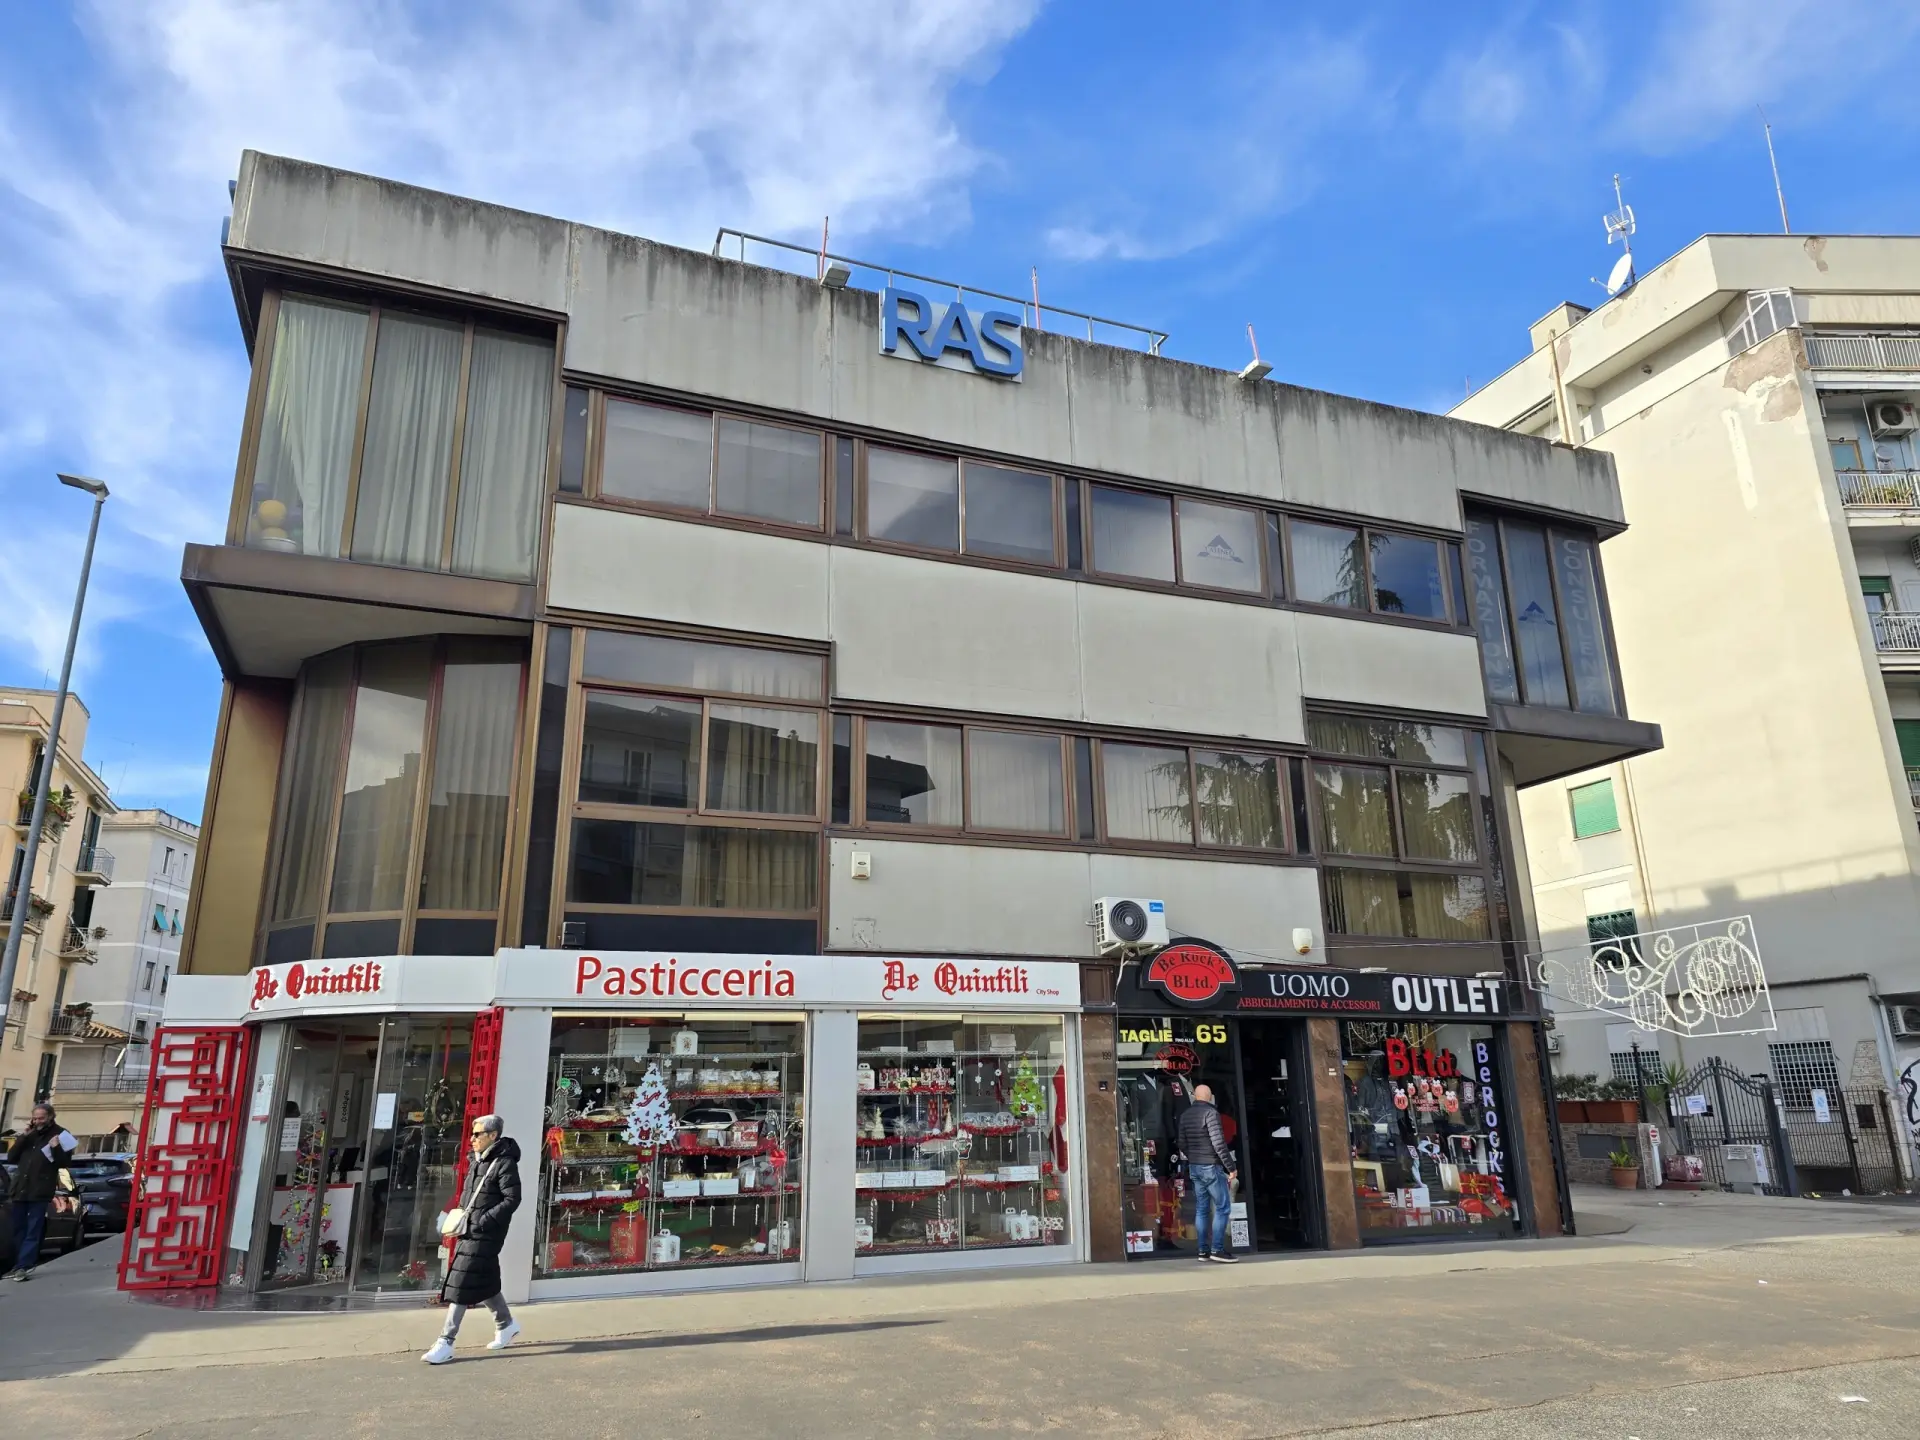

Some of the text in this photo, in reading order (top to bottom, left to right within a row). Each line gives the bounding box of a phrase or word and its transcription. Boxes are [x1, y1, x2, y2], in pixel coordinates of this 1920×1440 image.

[882, 287, 1025, 377] RAS
[1466, 519, 1505, 694] FORMAZIONE
[1562, 539, 1597, 708] CONSULENZA
[575, 956, 796, 997] Pasticceria
[881, 960, 920, 1001] De
[933, 961, 1030, 996] Quintili
[1035, 988, 1046, 996] City
[1157, 951, 1227, 975] Be Rock's
[1172, 975, 1214, 989] BLtd.
[250, 960, 382, 1011] De Quintili
[1238, 997, 1381, 1010] ABBIGLIAMENTO & ACCESSORI
[1267, 973, 1350, 998] UOMO
[1391, 976, 1500, 1014] OUTLET
[1120, 1029, 1173, 1043] TAGLIE
[1195, 1024, 1227, 1043] 65
